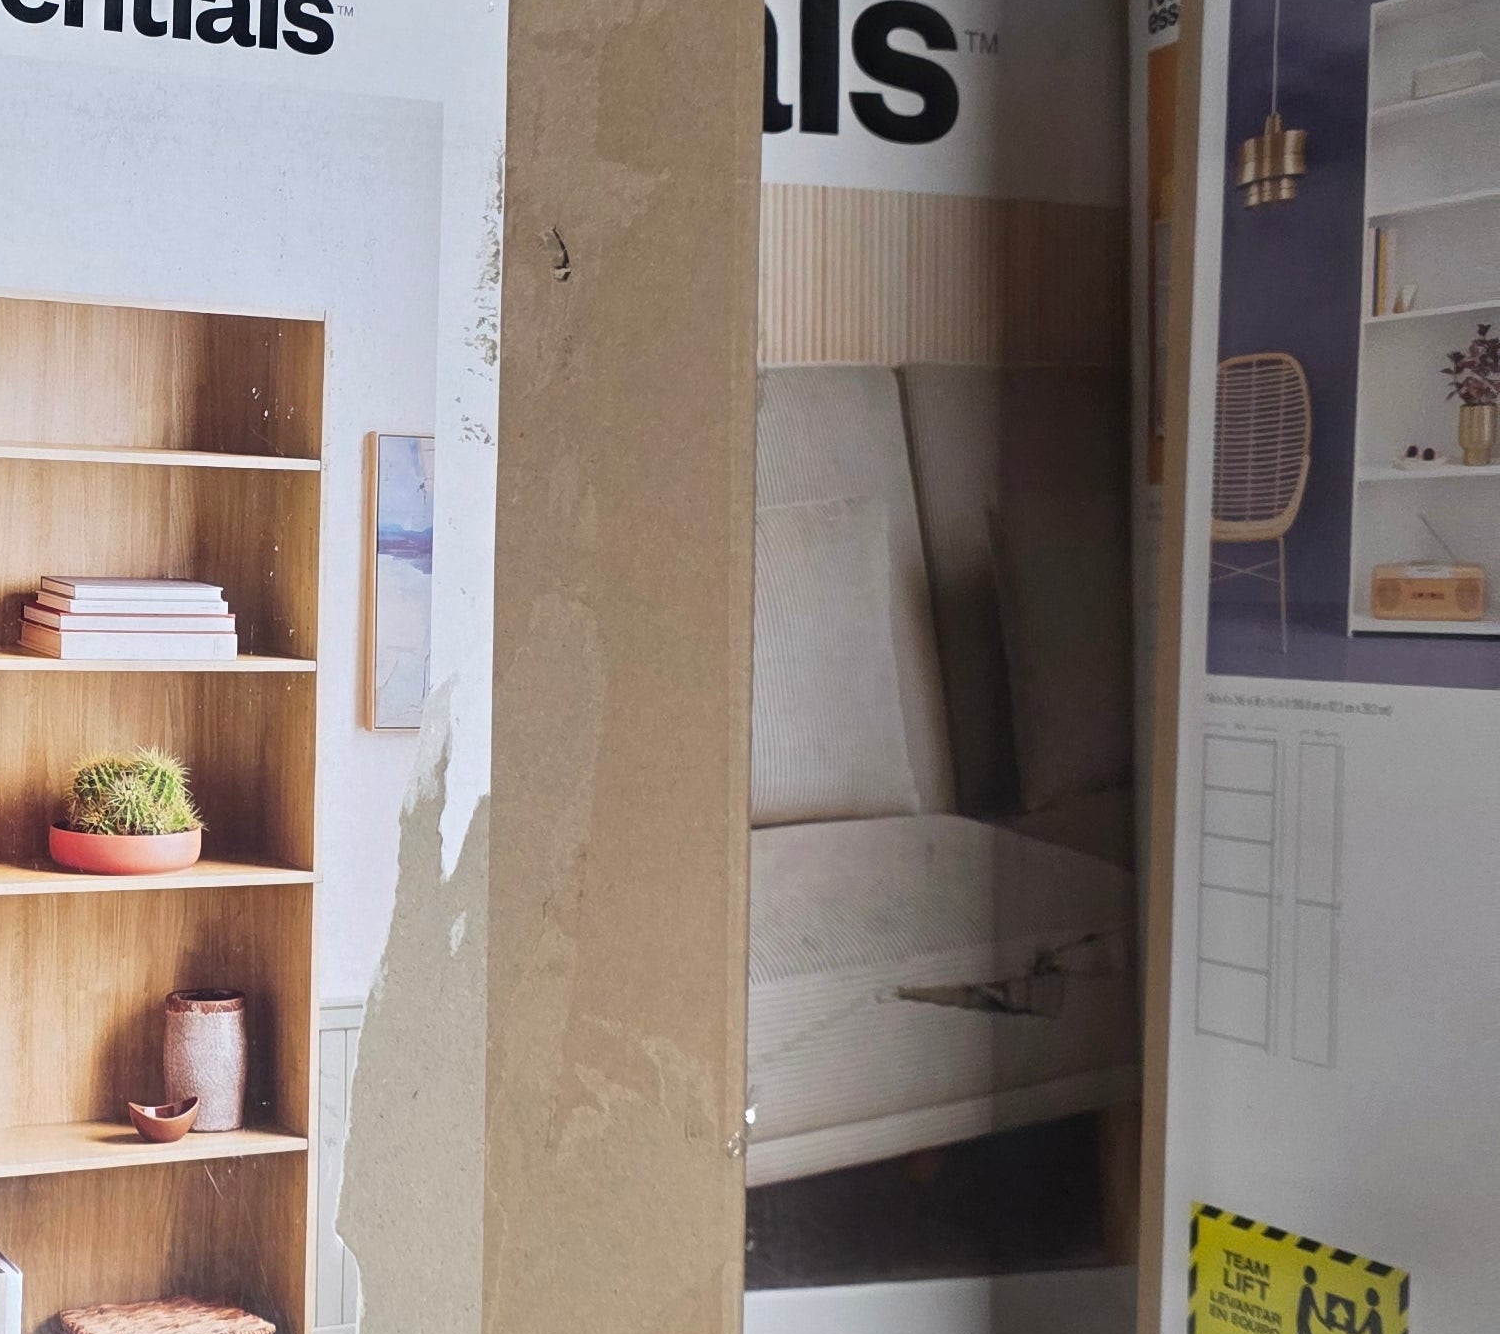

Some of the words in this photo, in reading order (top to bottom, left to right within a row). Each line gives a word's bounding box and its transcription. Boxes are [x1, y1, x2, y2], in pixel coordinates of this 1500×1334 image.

[1222, 1248, 1271, 1279] TEAM
[1223, 1267, 1271, 1302] LIFT
[1209, 1289, 1282, 1327] LEVANTAR
